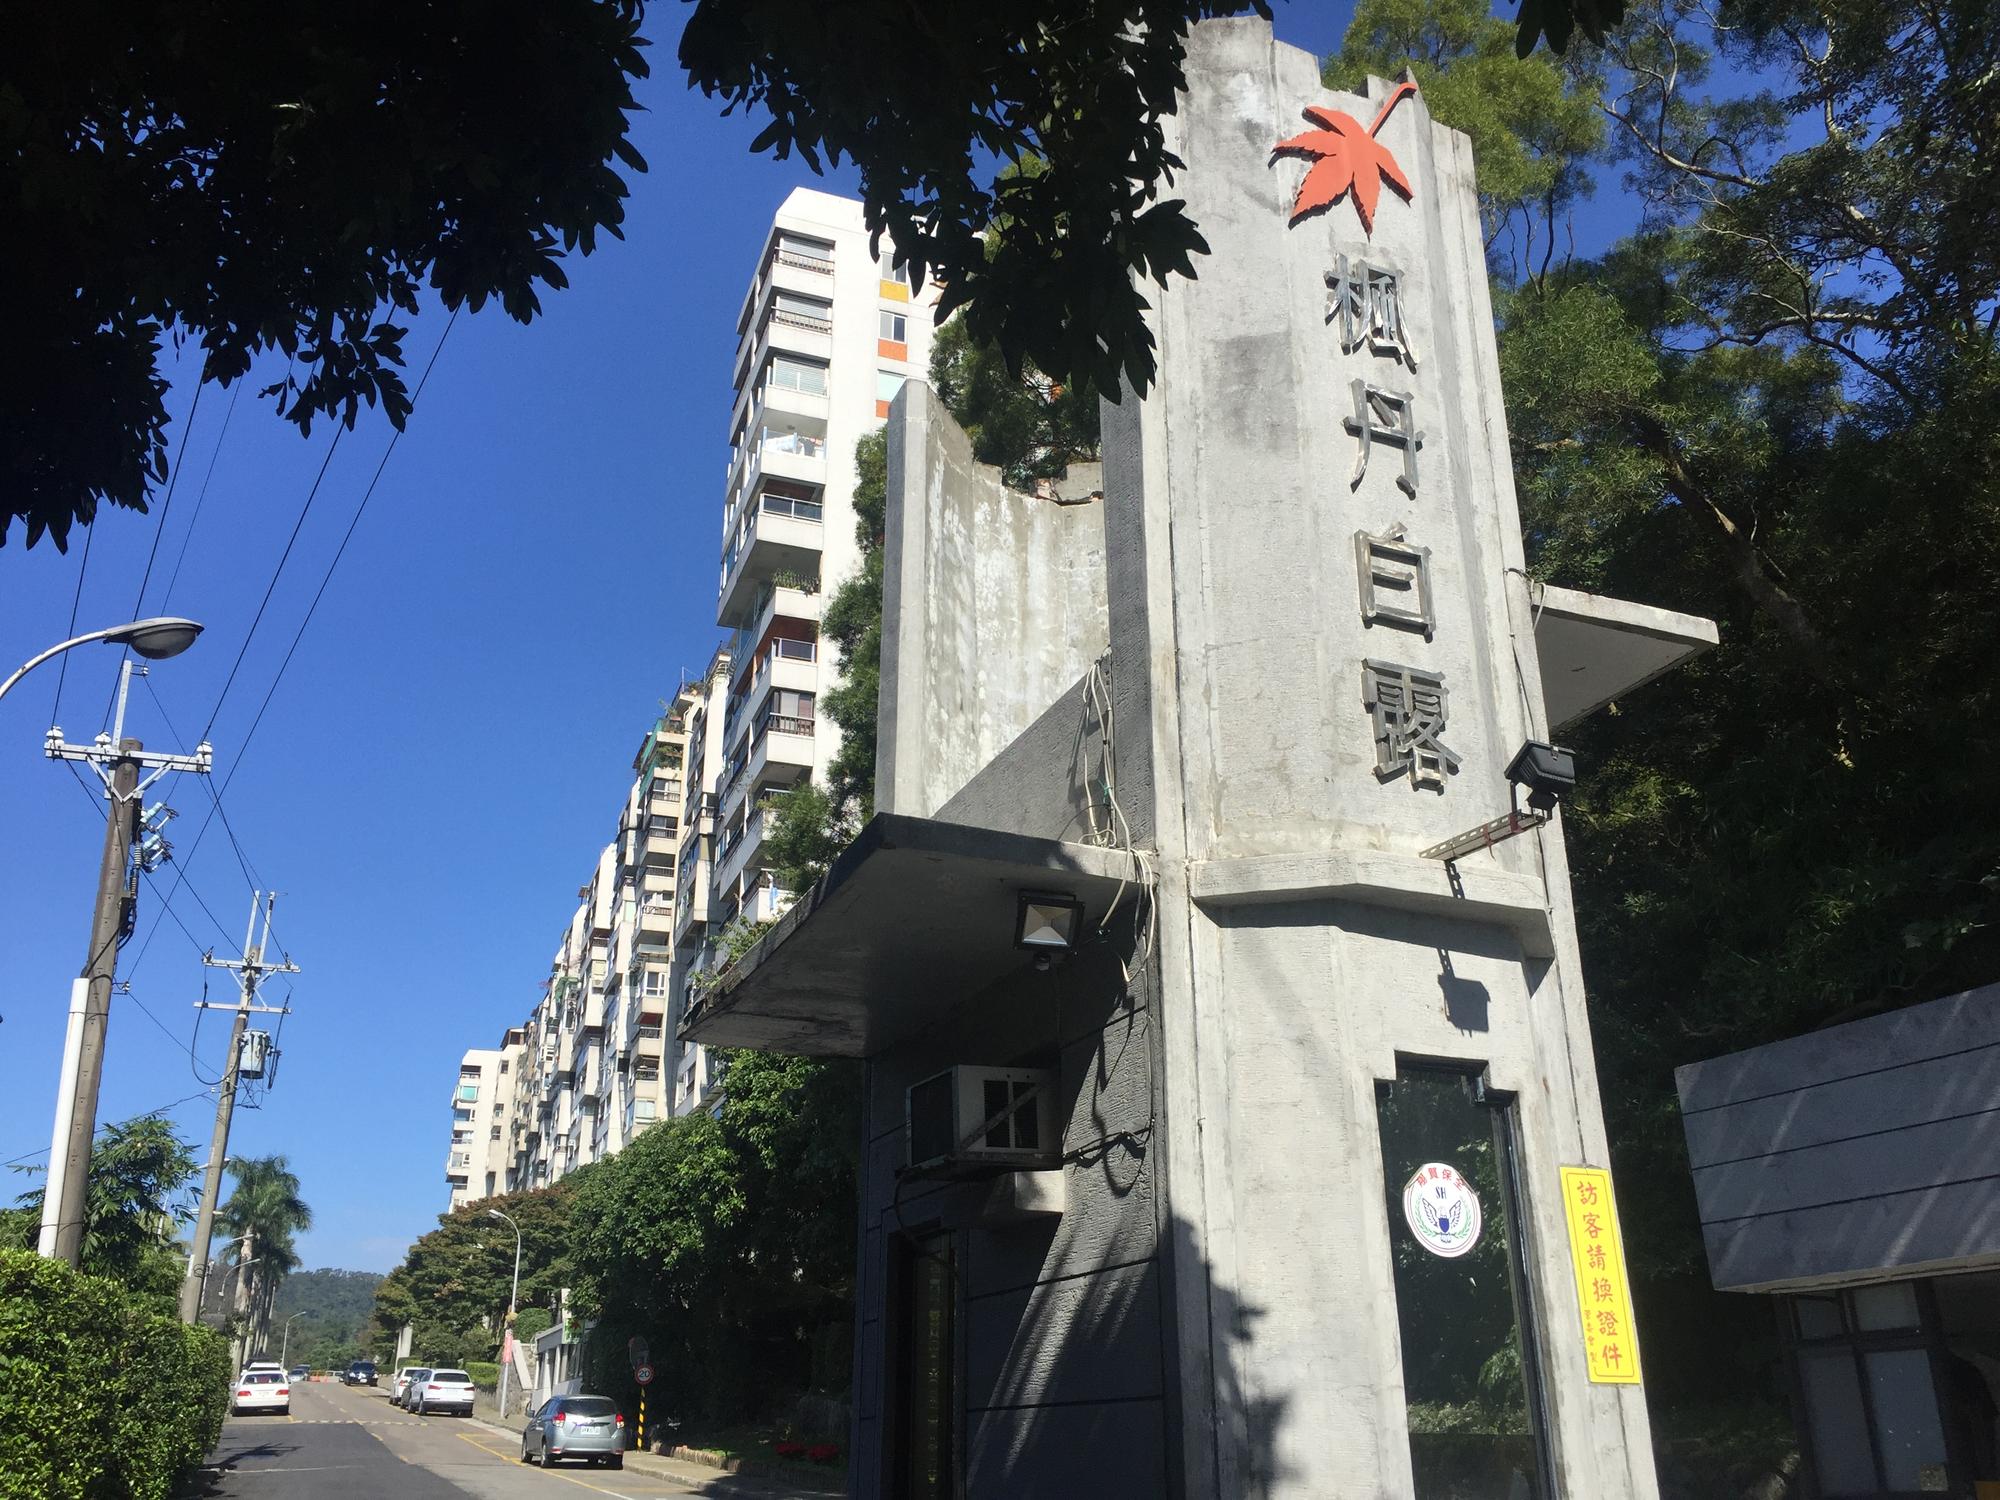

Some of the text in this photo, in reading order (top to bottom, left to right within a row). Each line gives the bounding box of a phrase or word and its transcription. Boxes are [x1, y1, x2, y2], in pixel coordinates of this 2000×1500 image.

[1323, 252, 1463, 796] 楓丹白露
[1435, 1186, 1447, 1199] SH
[1577, 1180, 1623, 1370] 訪客請換證件
[639, 1370, 650, 1378] 20
